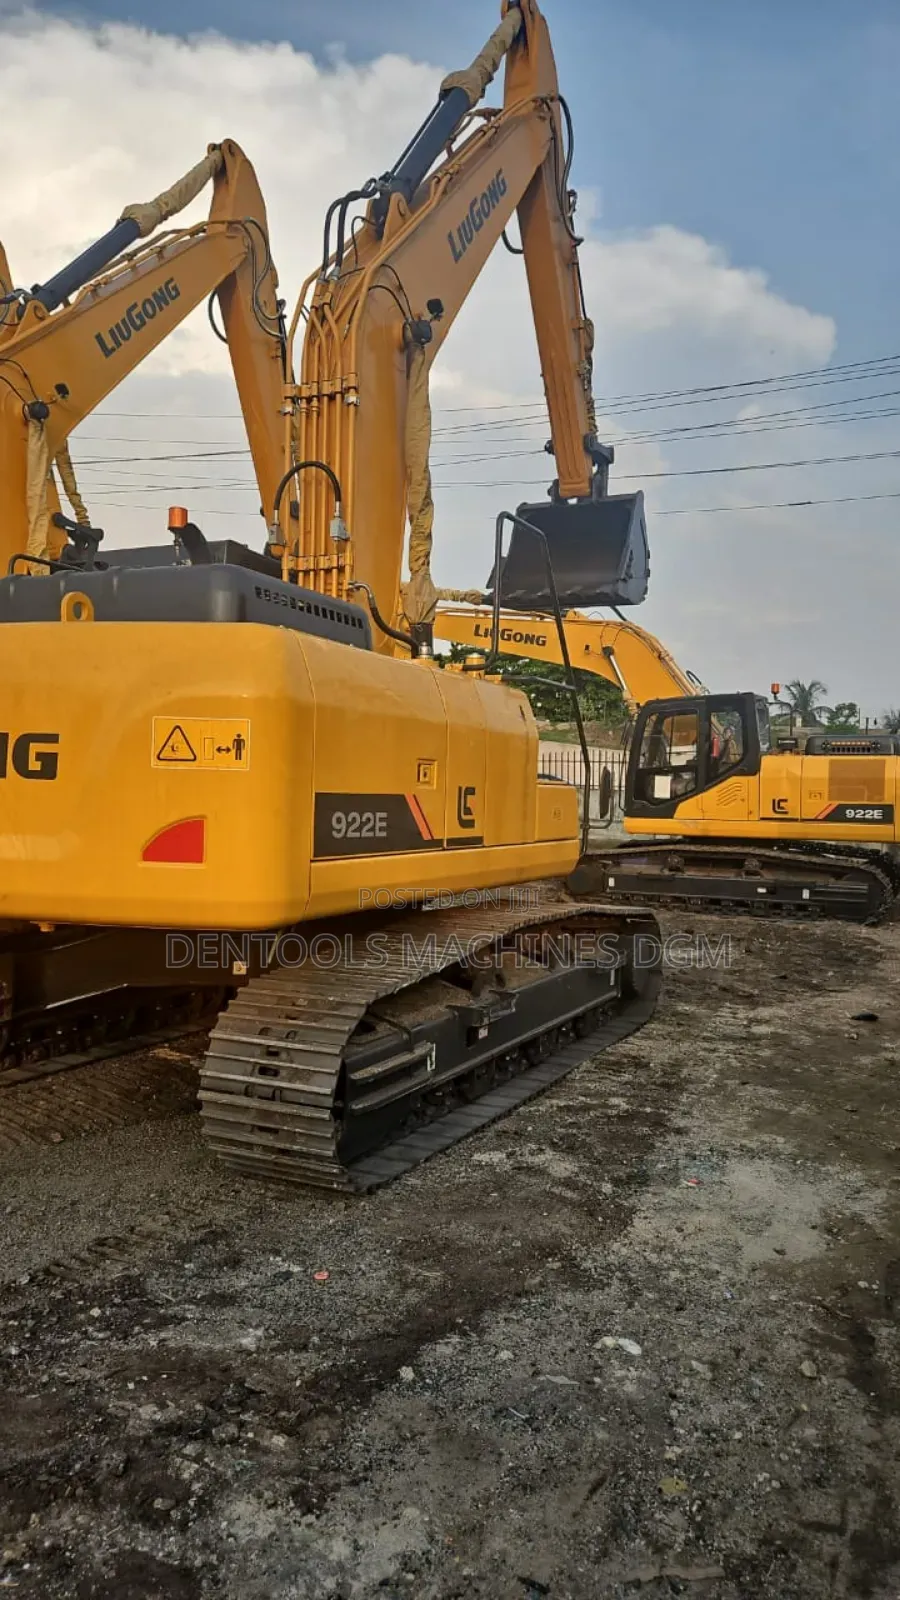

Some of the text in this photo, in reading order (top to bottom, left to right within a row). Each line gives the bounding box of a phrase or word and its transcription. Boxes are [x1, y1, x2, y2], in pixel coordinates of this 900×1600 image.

[473, 624, 547, 647] LIGONG
[0, 731, 60, 781] G
[331, 811, 388, 839] 922E
[845, 808, 884, 820] 922E
